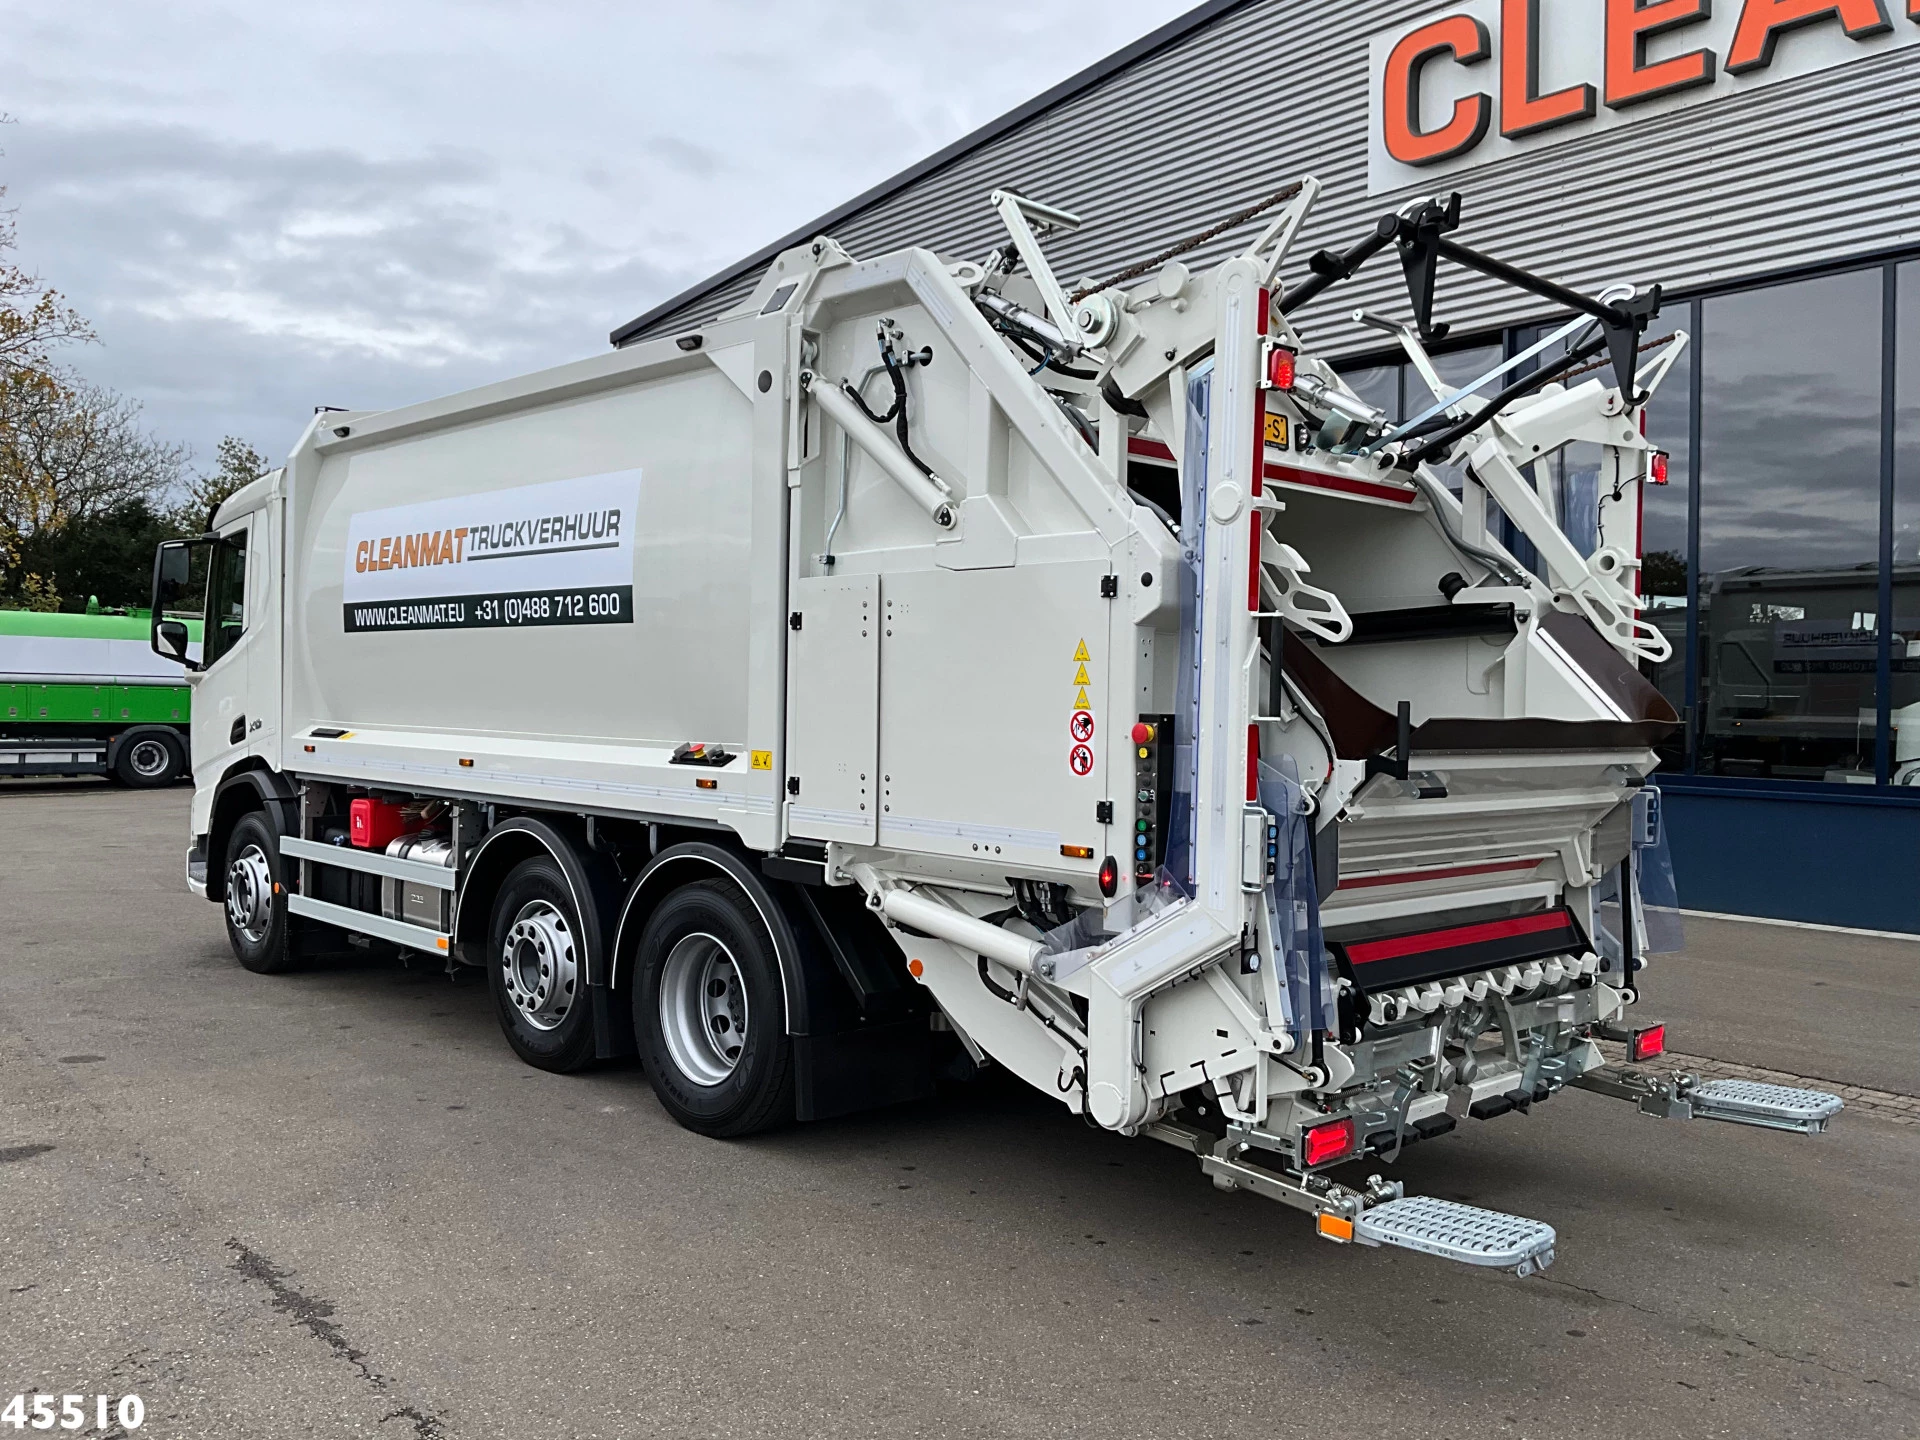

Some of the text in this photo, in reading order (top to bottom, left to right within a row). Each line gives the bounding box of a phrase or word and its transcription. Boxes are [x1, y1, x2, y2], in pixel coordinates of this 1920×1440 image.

[1383, 0, 1920, 166] CLE
[355, 509, 621, 573] CLEANMAT TRUCKVERHUUR
[354, 593, 620, 627] WWW.CLEANMAT.EU +31 (0)488 712 600
